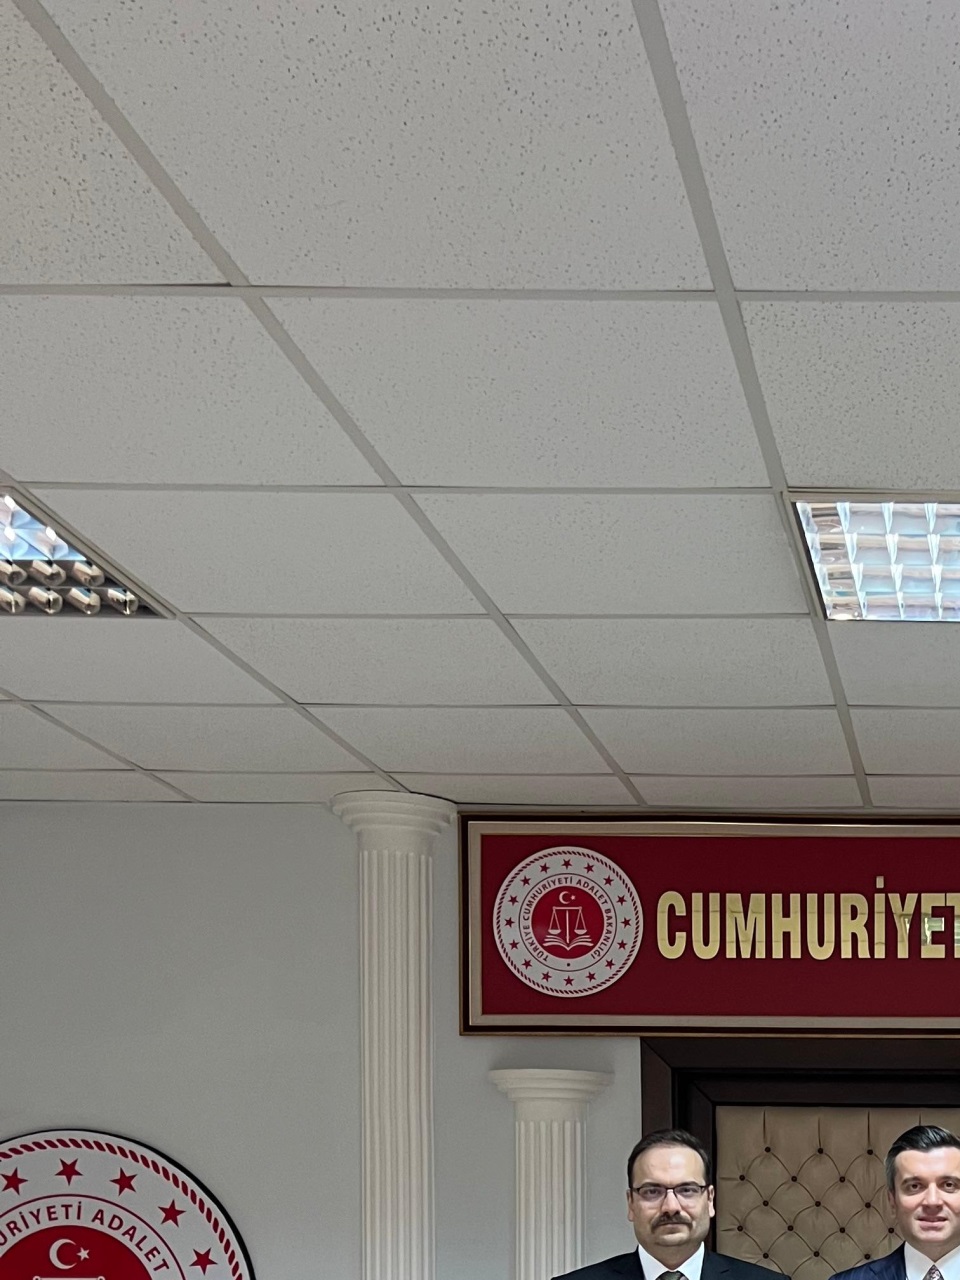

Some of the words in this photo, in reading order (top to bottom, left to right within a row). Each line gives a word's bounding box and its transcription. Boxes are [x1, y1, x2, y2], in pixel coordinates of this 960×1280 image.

[522, 876, 573, 921] CUMHURİYETİ
[576, 879, 608, 906] ADALET
[522, 925, 550, 962] TÜRKİYE
[590, 908, 613, 960] BAKANLIĞI
[91, 1208, 170, 1272] ADALET
